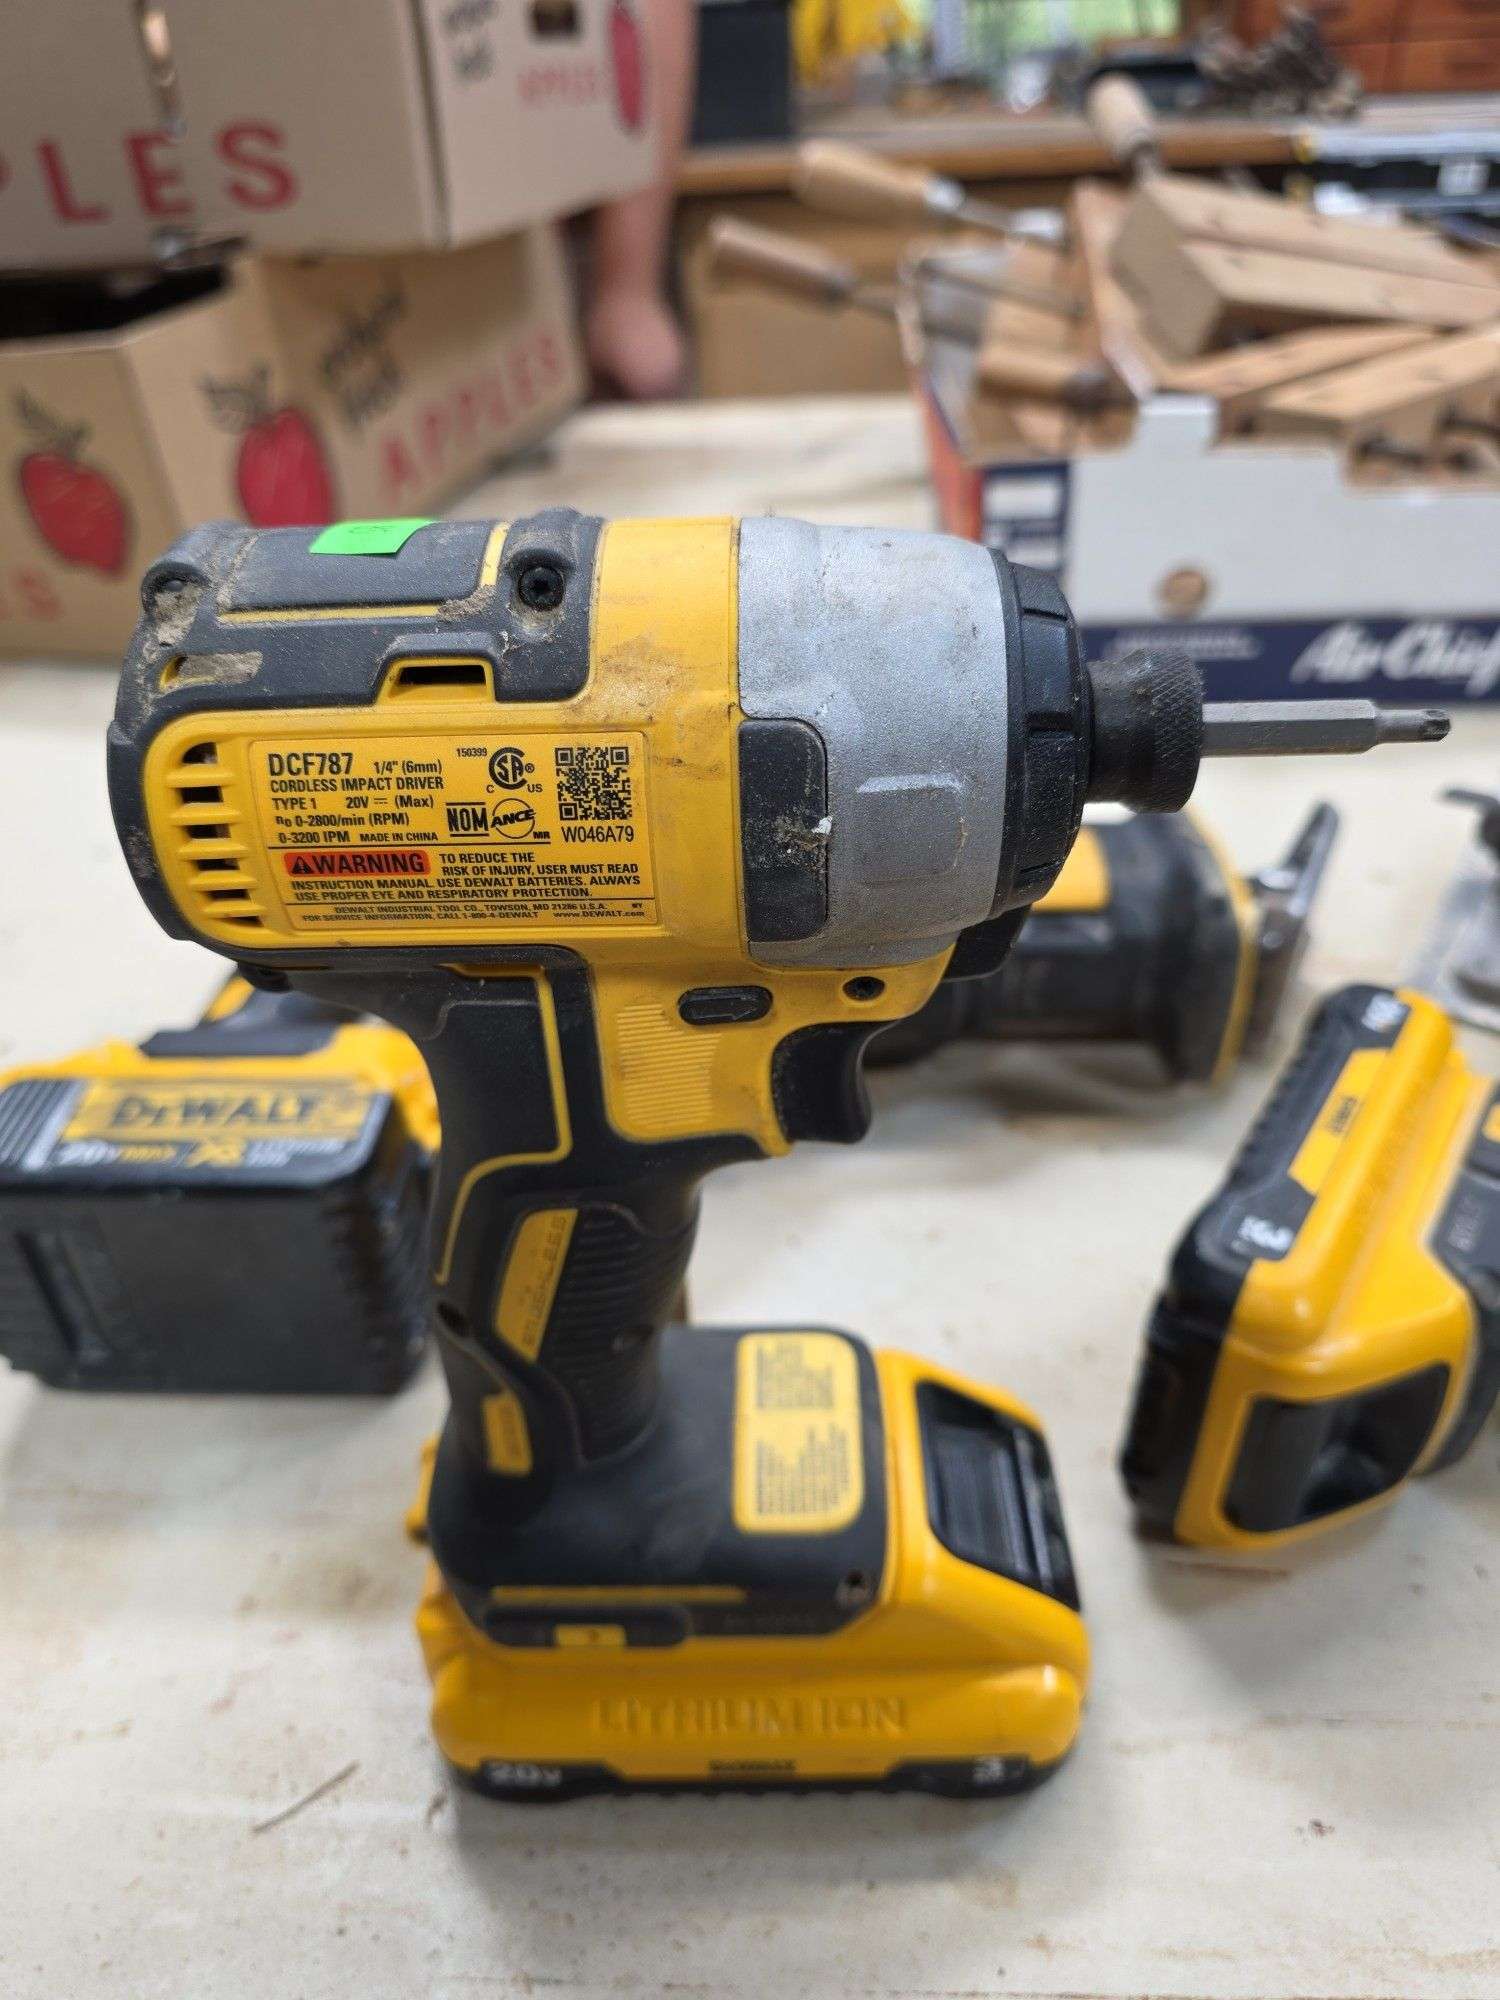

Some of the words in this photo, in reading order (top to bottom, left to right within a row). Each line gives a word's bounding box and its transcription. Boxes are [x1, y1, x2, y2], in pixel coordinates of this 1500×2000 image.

[268, 752, 353, 776] DCF787
[373, 760, 399, 775] 1/4"
[402, 759, 442, 775] (6mm)
[270, 779, 338, 793] CORDLESS
[341, 777, 393, 791] IMPACT
[396, 776, 444, 790] DRIVER
[486, 784, 495, 794] C
[527, 783, 543, 793] US
[272, 797, 307, 810] TYPE
[310, 798, 317, 809] 1
[346, 796, 369, 809] 20V
[394, 795, 434, 809] (Max)
[295, 814, 365, 827] 0-2800/min
[369, 812, 410, 826] (RPM)
[446, 806, 489, 832] NOM
[490, 808, 536, 829] ANCE
[279, 832, 320, 843] 0-3200
[323, 831, 350, 843] IPM
[360, 834, 389, 842] MADE
[392, 833, 404, 842] IN
[406, 832, 438, 842] CHINA
[561, 825, 634, 843] W046A79
[312, 852, 425, 874] WARNING
[439, 853, 456, 864] TO
[460, 852, 507, 863] REDUCE
[511, 852, 535, 863] THE
[441, 866, 469, 876] RISK
[472, 866, 486, 876] OF
[538, 864, 567, 875] USER
[571, 863, 604, 874] MUST
[607, 863, 638, 874] READ
[291, 880, 374, 891] INSTRUCTION
[437, 878, 461, 888] USE
[464, 877, 513, 888] DEWALT
[590, 875, 640, 886] ALWAYS
[295, 892, 321, 902] USE
[323, 891, 370, 901] PROPER
[373, 891, 395, 900] EYE
[398, 890, 424, 900] AND
[427, 889, 508, 899] RESPIRATORY
[377, 905, 433, 913] INDUSTRIAL
[438, 904, 462, 912] TOOL
[437, 912, 462, 920] CALL
